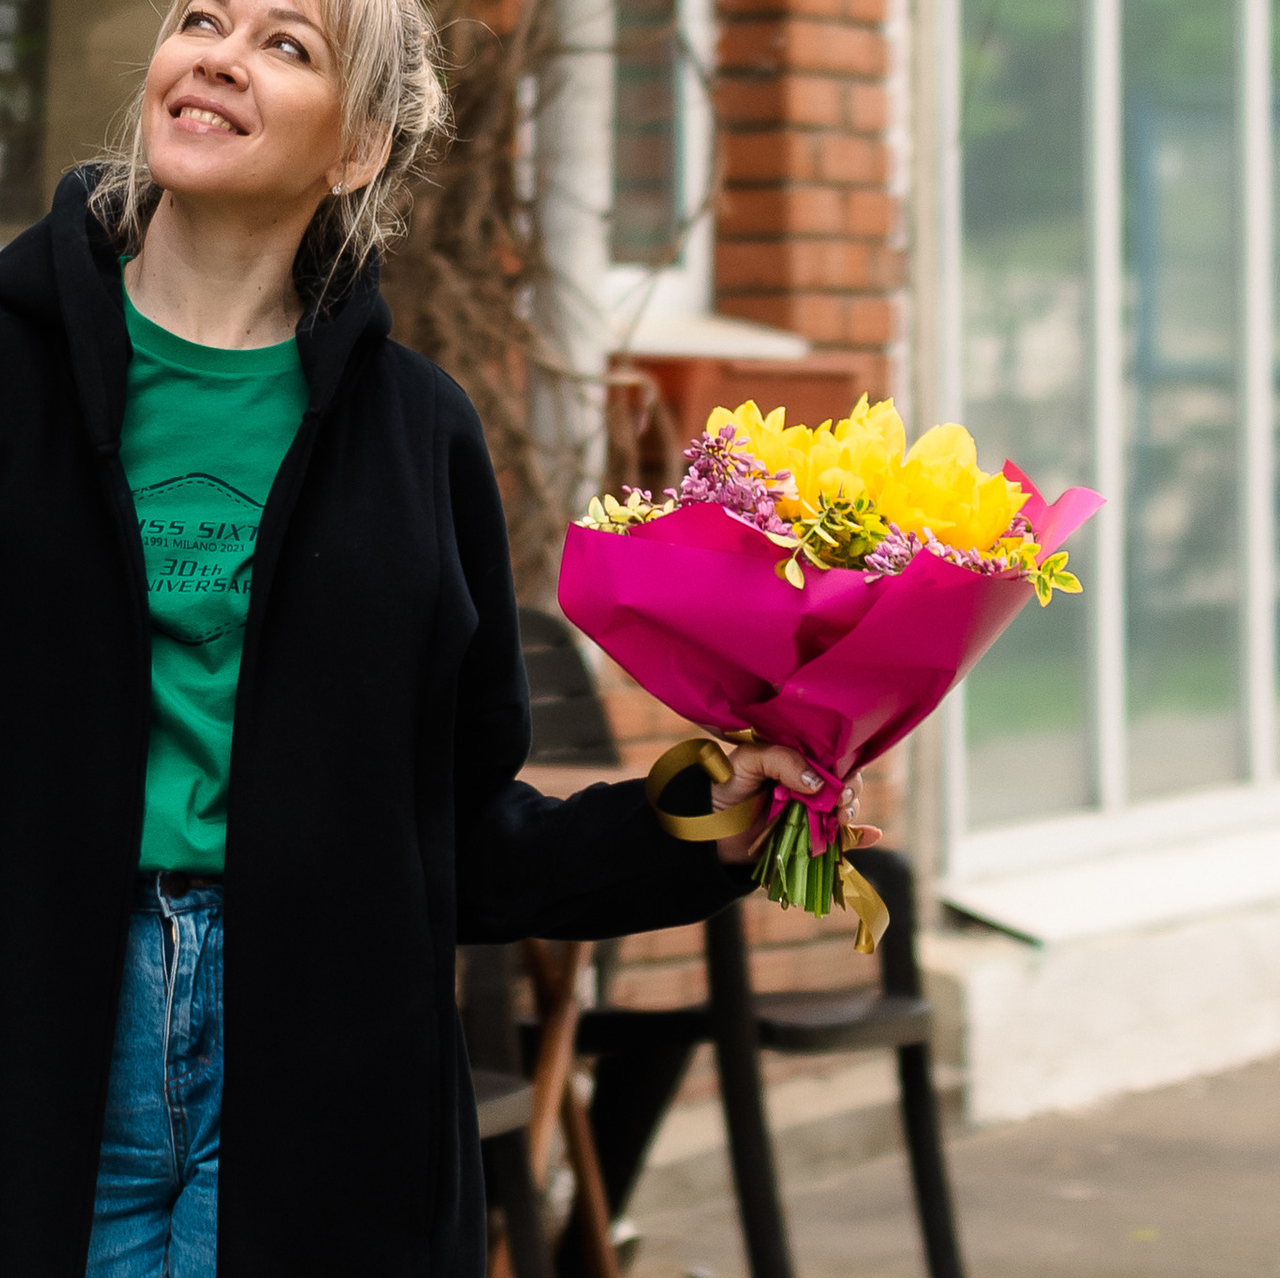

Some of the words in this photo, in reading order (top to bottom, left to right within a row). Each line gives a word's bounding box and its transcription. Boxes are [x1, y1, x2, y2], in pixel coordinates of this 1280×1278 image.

[144, 537, 168, 548] 1991
[173, 538, 217, 552] MILANO
[220, 543, 245, 553] 2021
[159, 558, 222, 577] 30th
